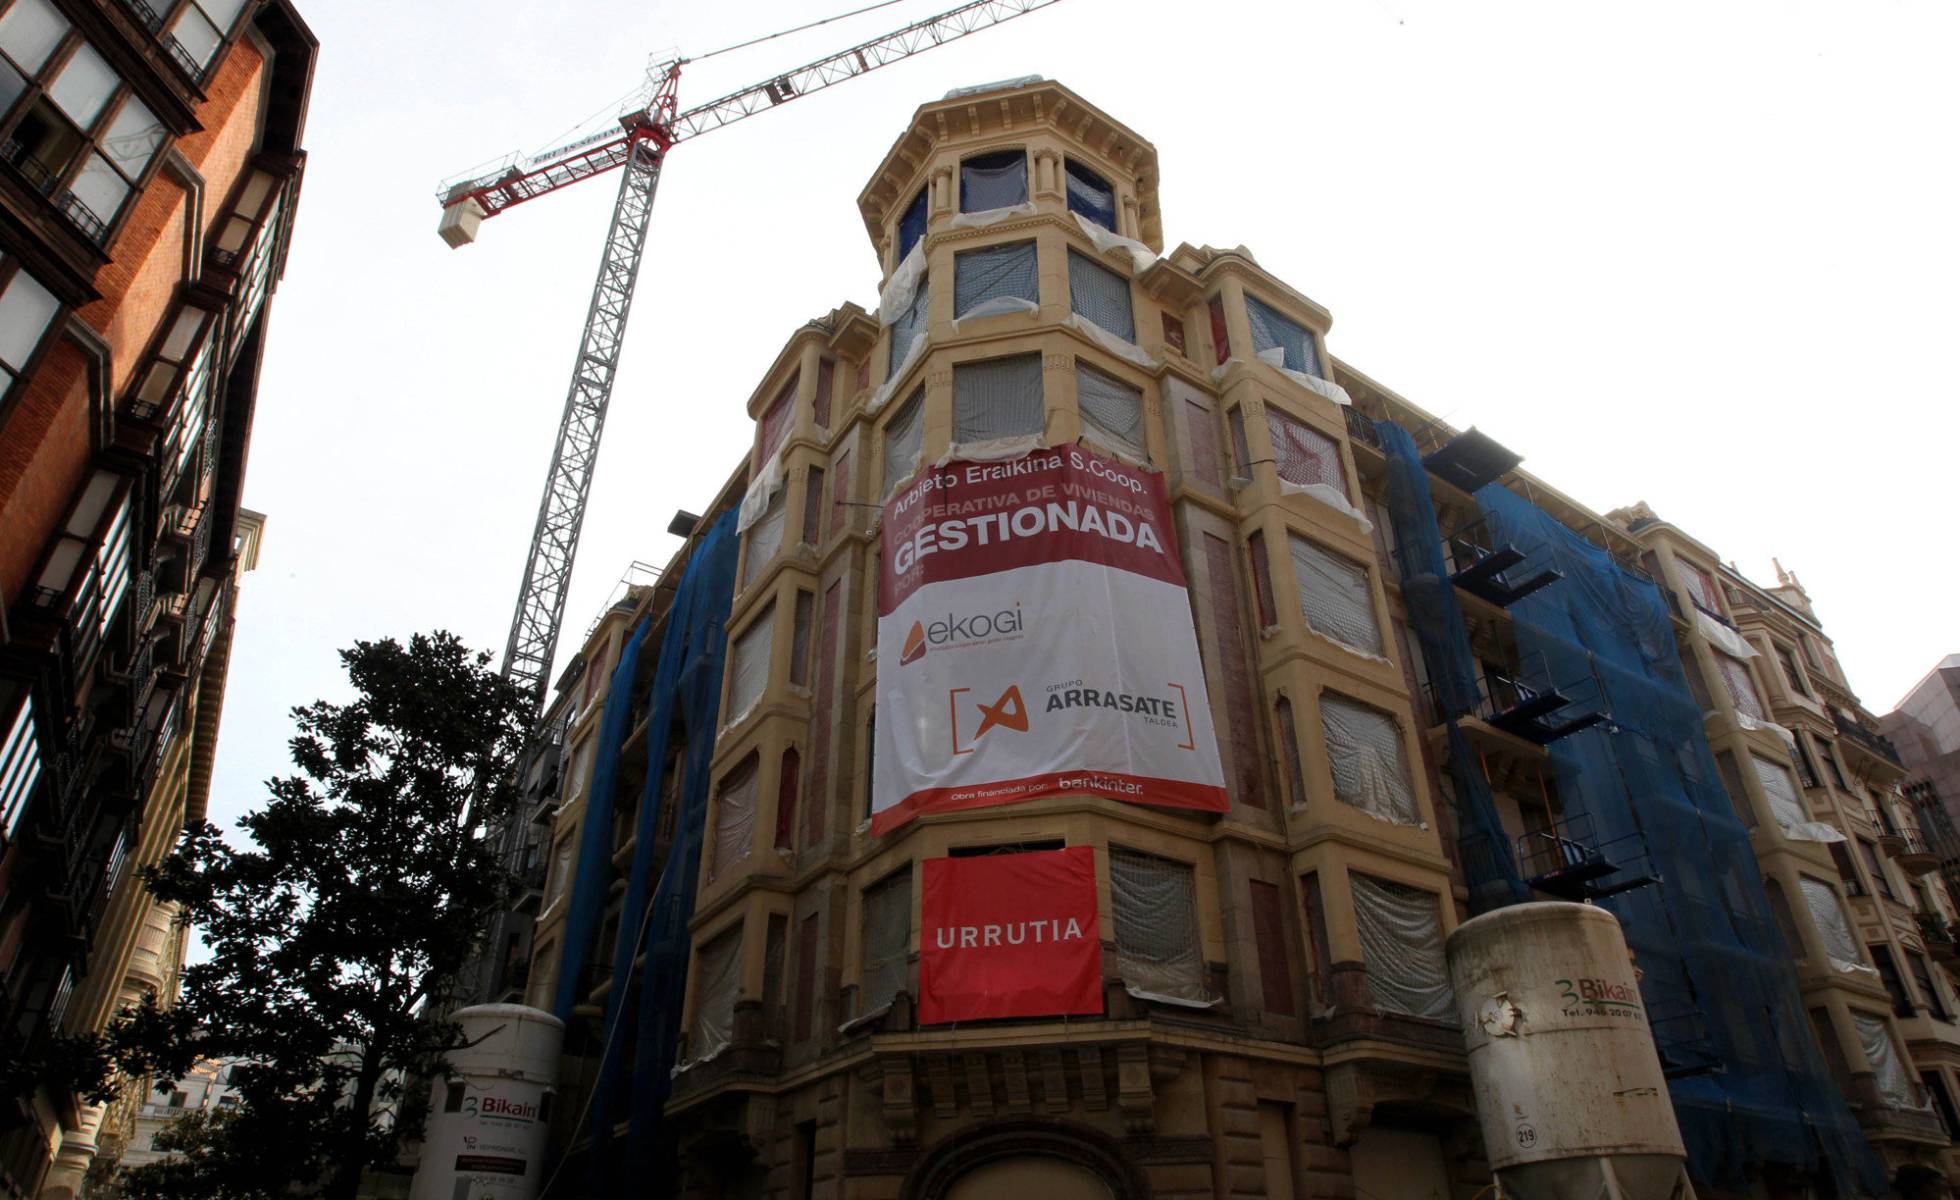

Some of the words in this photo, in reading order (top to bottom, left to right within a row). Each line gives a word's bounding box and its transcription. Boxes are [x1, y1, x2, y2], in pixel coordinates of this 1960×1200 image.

[893, 472, 957, 520] Arbieto
[966, 452, 1063, 484] Eraikina
[1070, 451, 1148, 495] S.Coop.
[894, 491, 1021, 545] COOPERATIVA
[1026, 484, 1057, 501] DE
[1062, 482, 1156, 522] VIVIENDAS
[894, 500, 1164, 576] GESTIONADA
[1046, 679, 1083, 693] GRUPO
[1045, 688, 1177, 720] ARRASATE
[1143, 715, 1179, 729] TALDEA
[950, 789, 975, 801] Obra
[976, 784, 1027, 800] financiada
[1028, 783, 1049, 796] por:
[936, 917, 1084, 949] URRUTIA
[482, 1097, 537, 1119] Bikain
[1519, 1130, 1534, 1142] 219
